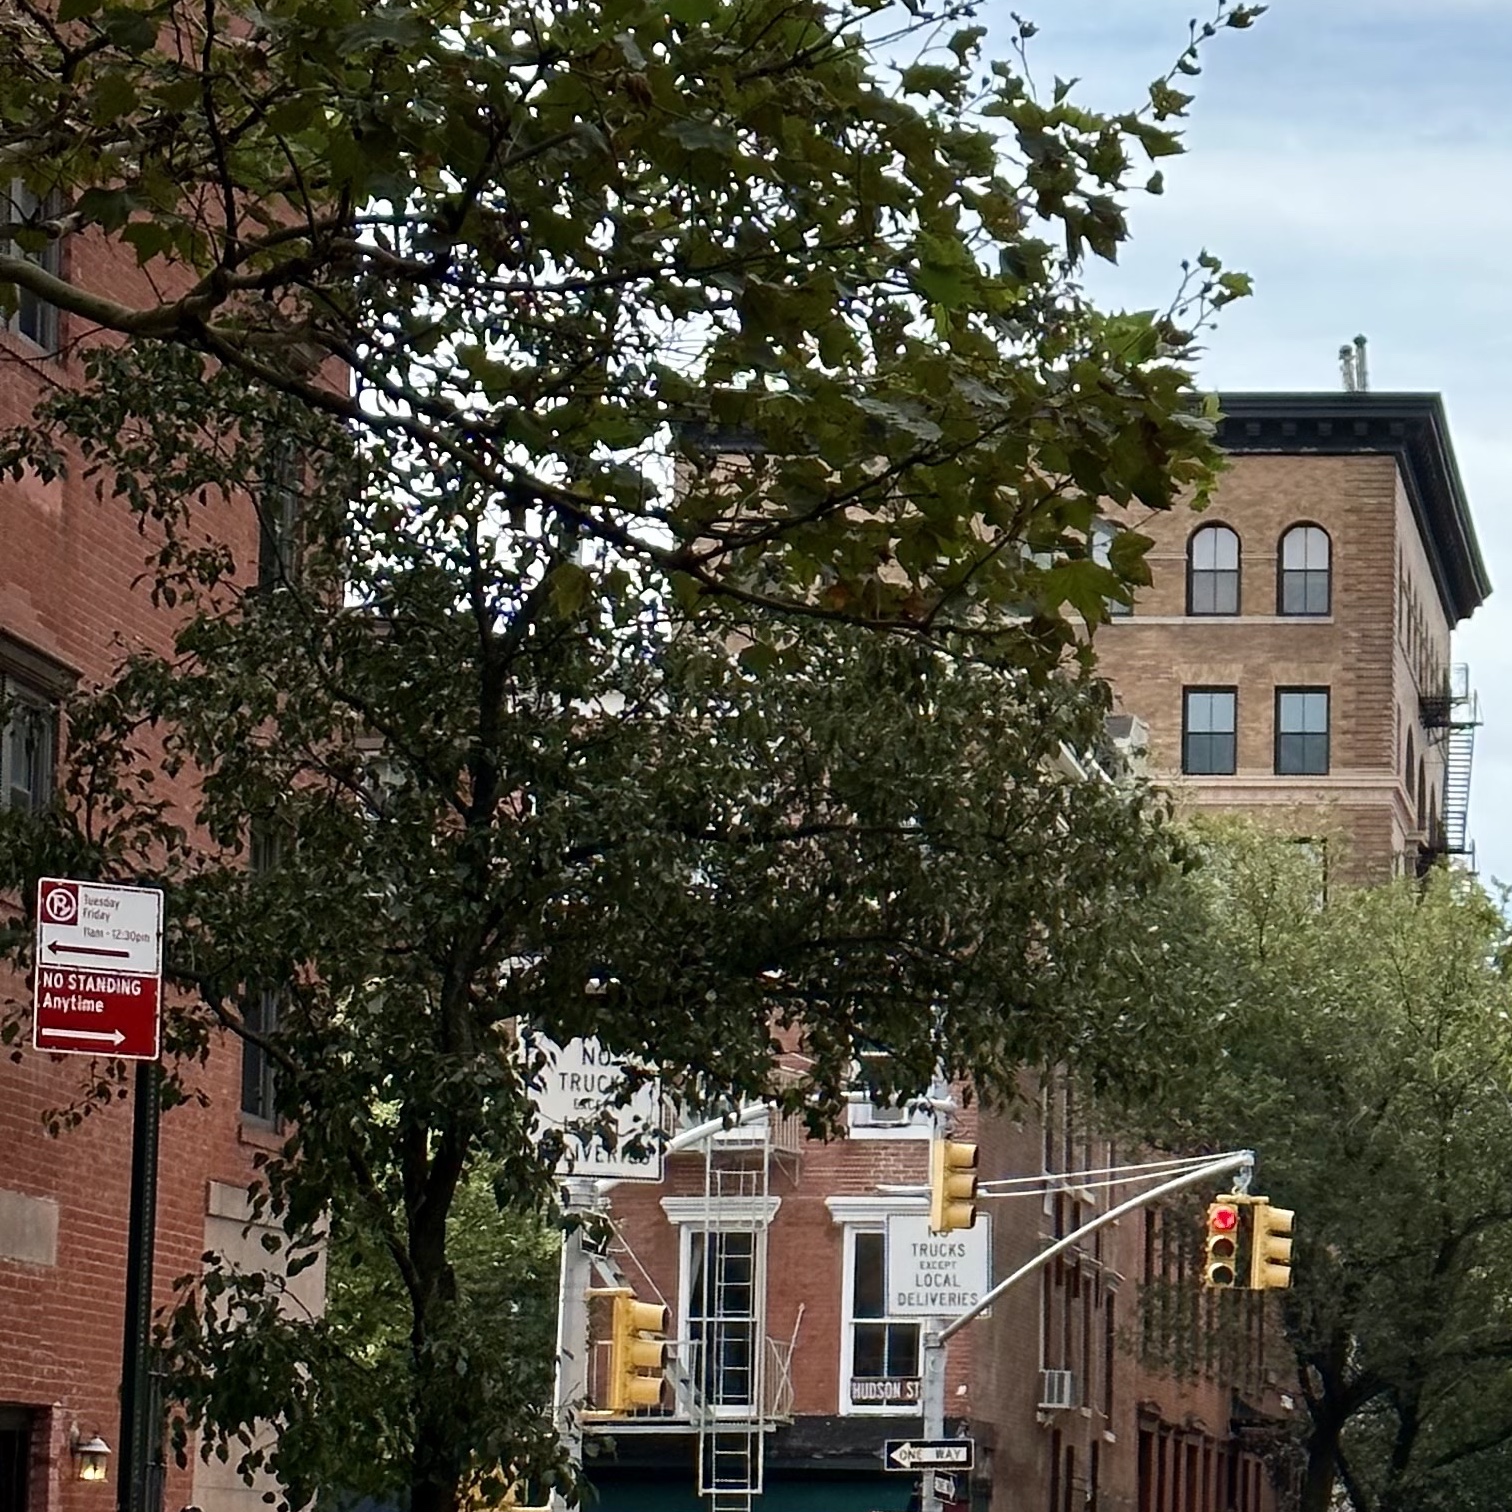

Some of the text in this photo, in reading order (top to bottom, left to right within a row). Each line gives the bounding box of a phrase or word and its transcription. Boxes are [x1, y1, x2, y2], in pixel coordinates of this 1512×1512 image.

[83, 894, 120, 911] Tuesday
[82, 907, 111, 923] Friday
[43, 970, 141, 996] NO STANDING
[42, 992, 104, 1014] Anytime
[911, 1243, 966, 1257] TRUCKS
[919, 1260, 957, 1270] EXCEPT
[915, 1273, 961, 1287] LOCAL
[897, 1292, 978, 1307] DELIVERIES
[852, 1381, 920, 1399] HUDSON ST
[899, 1448, 962, 1461] ONE WAY
